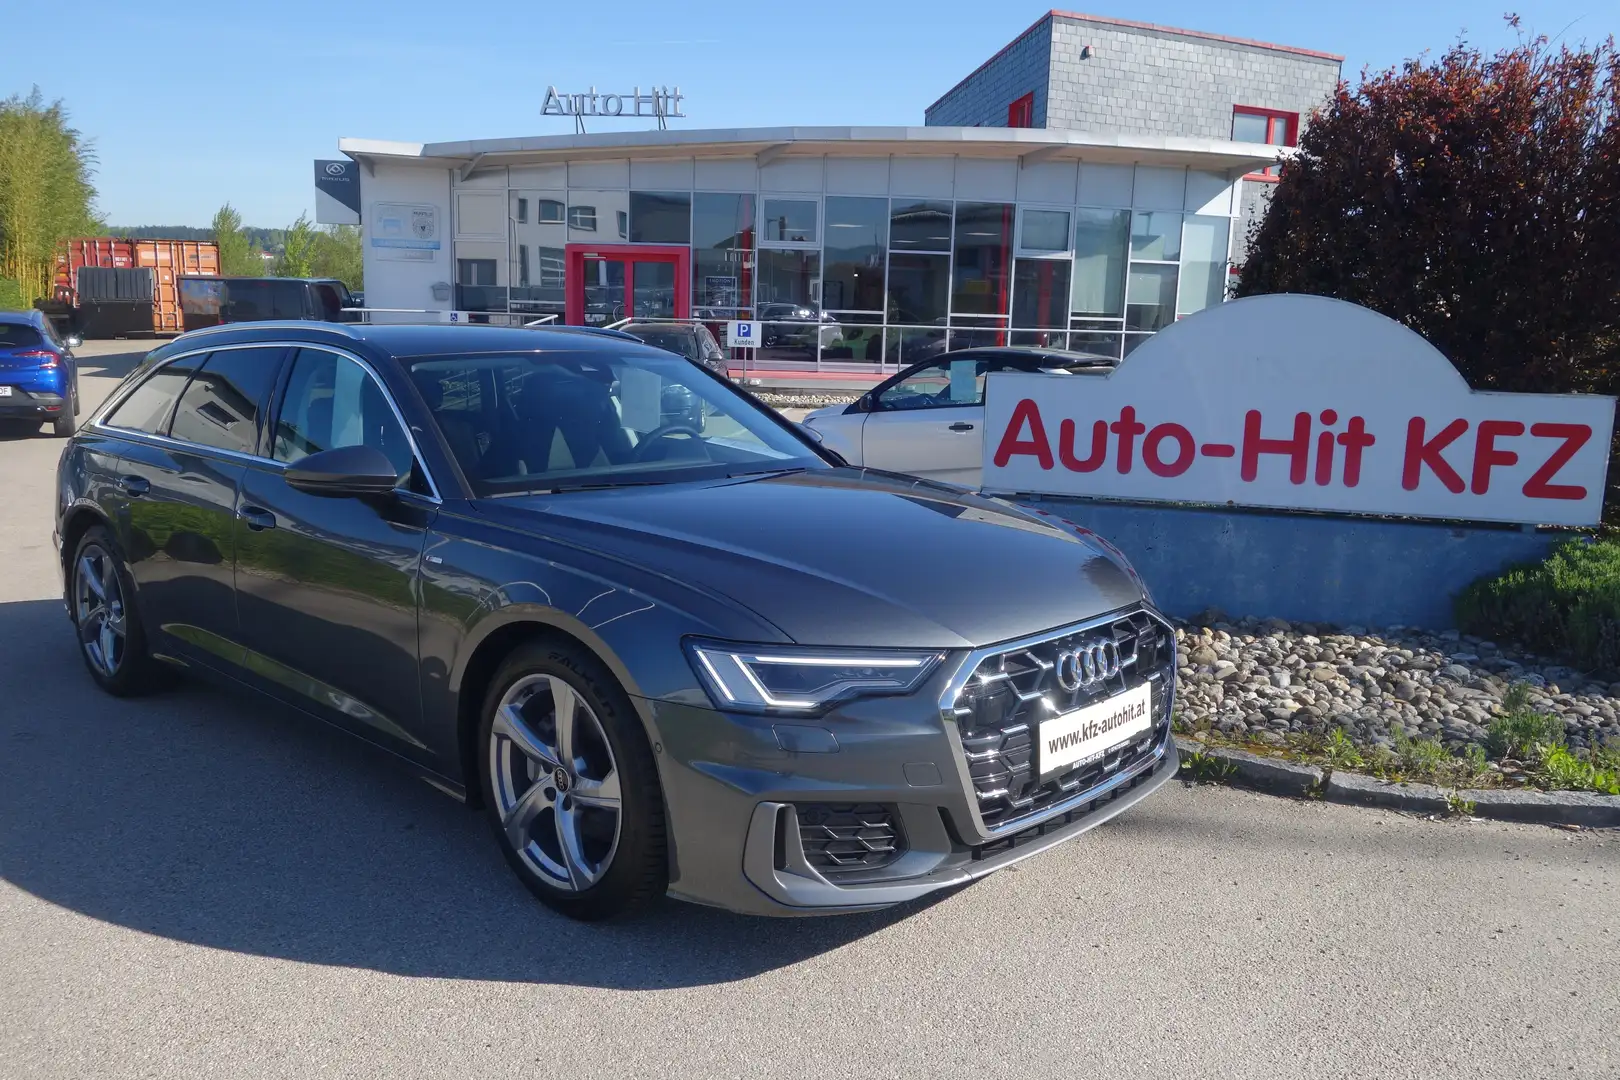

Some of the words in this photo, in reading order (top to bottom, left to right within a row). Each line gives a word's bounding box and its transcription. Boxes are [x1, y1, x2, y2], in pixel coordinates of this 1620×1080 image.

[540, 85, 622, 116] Auto
[634, 85, 685, 117] Hit
[740, 324, 748, 336] P
[993, 398, 1376, 488] Auto-Hit
[1402, 416, 1593, 500] KFZ
[1048, 699, 1146, 754] www.kfz-autohit.at
